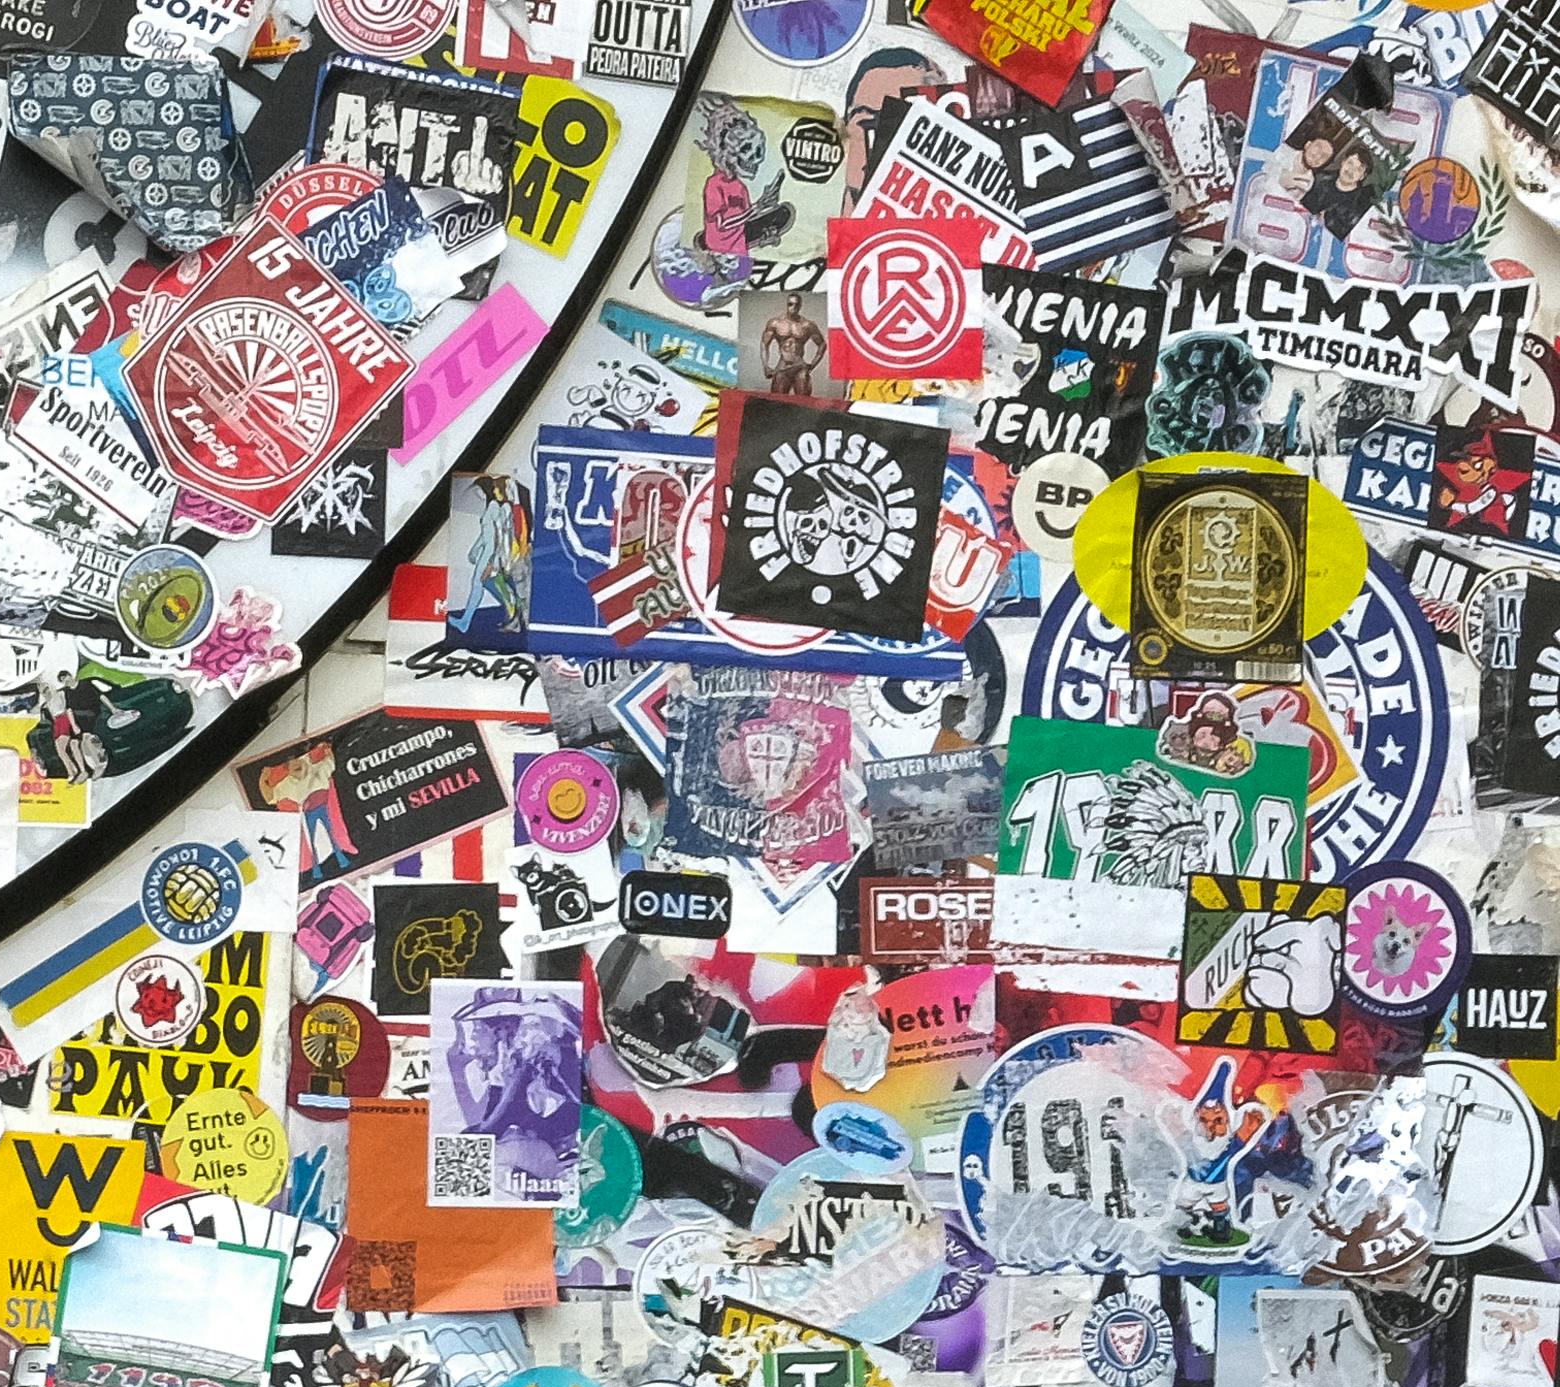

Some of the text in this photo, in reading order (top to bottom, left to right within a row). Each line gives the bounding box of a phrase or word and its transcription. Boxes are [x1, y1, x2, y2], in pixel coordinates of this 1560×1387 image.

[595, 13, 684, 55] OUTTA
[588, 49, 628, 73] PEDRA
[785, 139, 841, 163] VINTRO
[294, 262, 400, 381] JAHRE
[1168, 252, 1530, 404] MCMXXI
[1036, 480, 1090, 508] BP
[345, 721, 455, 777] Cruzcampo,
[355, 740, 479, 803] Chicharrones
[408, 768, 483, 809] SEVILLA
[1466, 988, 1548, 1031] HAUZ
[184, 1110, 247, 1133] Ernte
[189, 1134, 232, 1159] gut.
[192, 1160, 248, 1182] Alles
